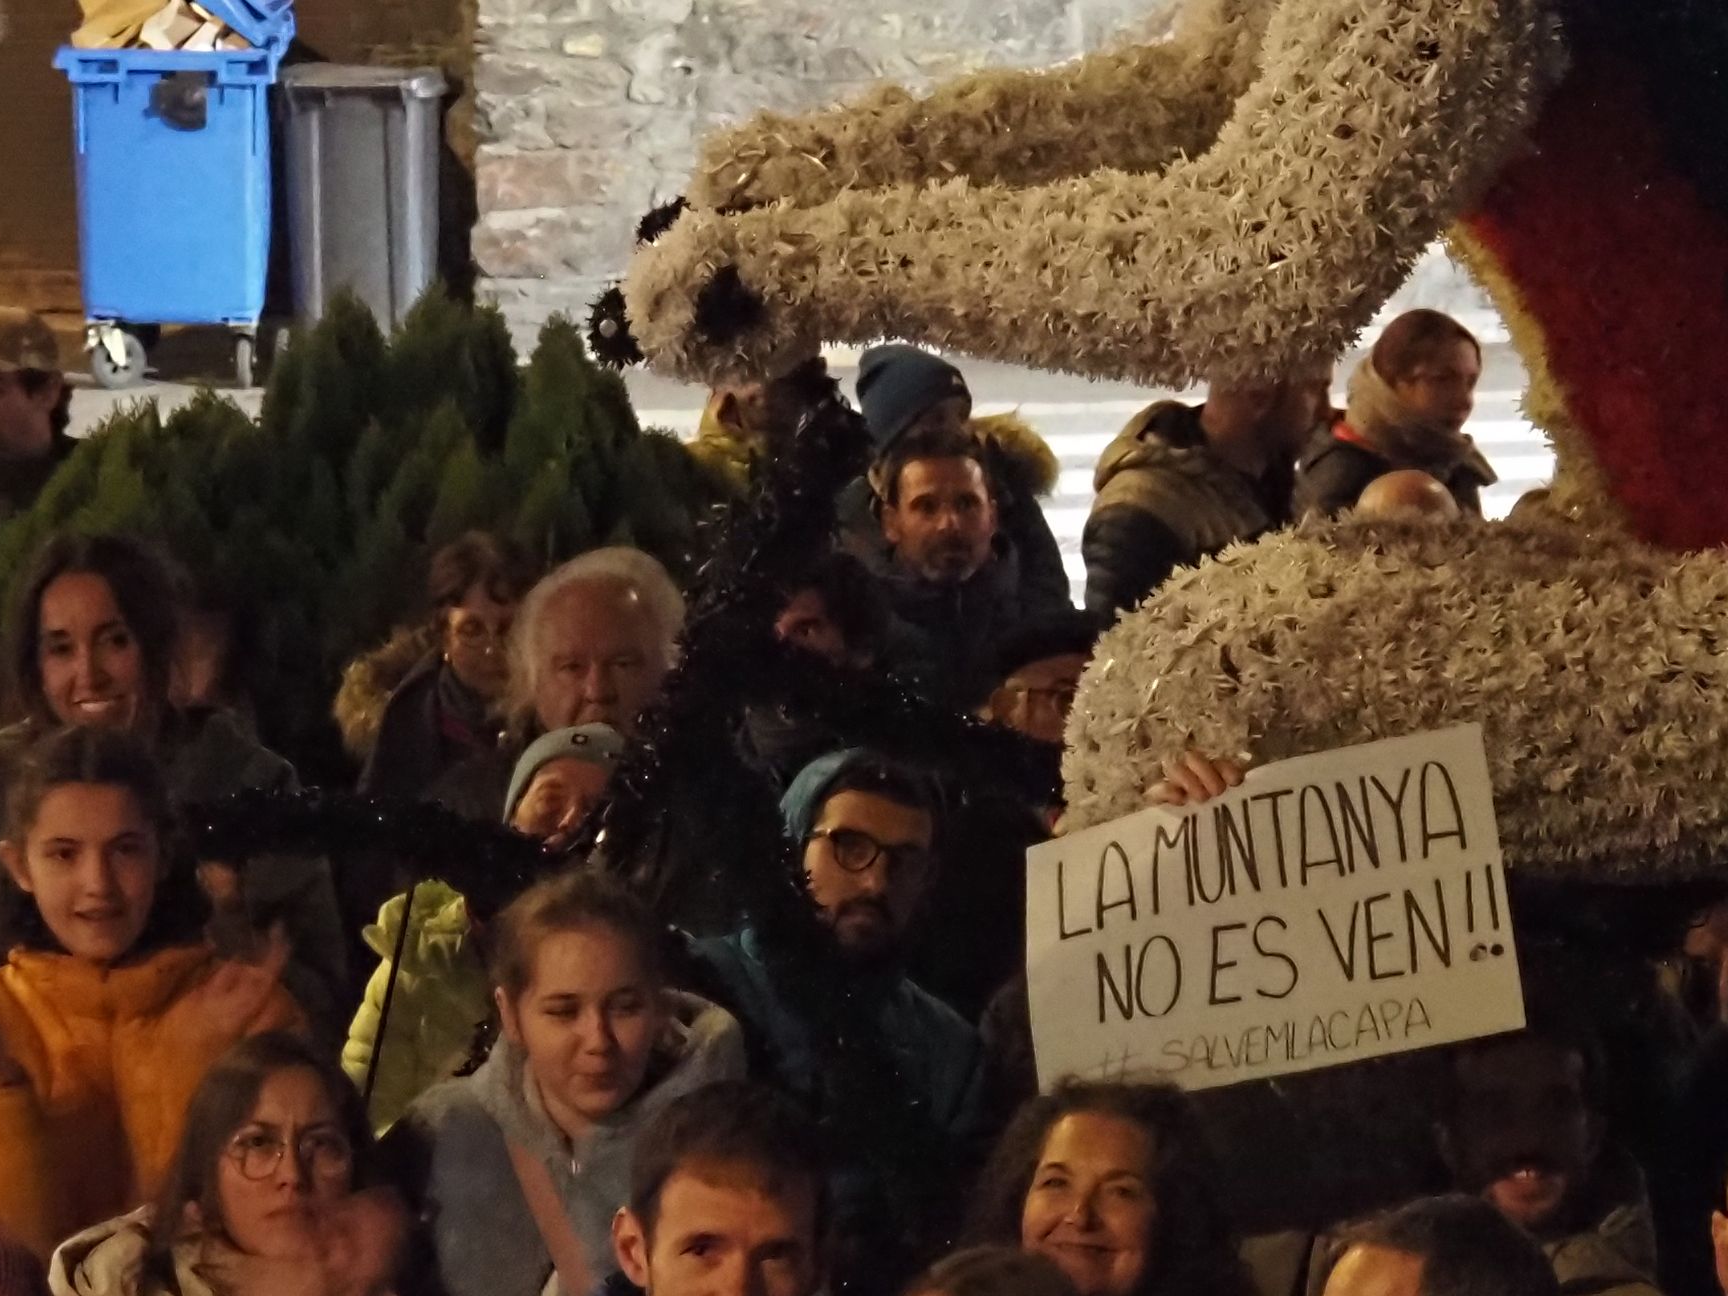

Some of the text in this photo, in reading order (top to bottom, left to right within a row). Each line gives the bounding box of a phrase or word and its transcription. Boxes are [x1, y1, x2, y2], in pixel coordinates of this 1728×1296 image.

[1057, 760, 1468, 940] LA MUNTANYA
[1096, 934, 1183, 1024] NO
[1209, 914, 1299, 1006] ES
